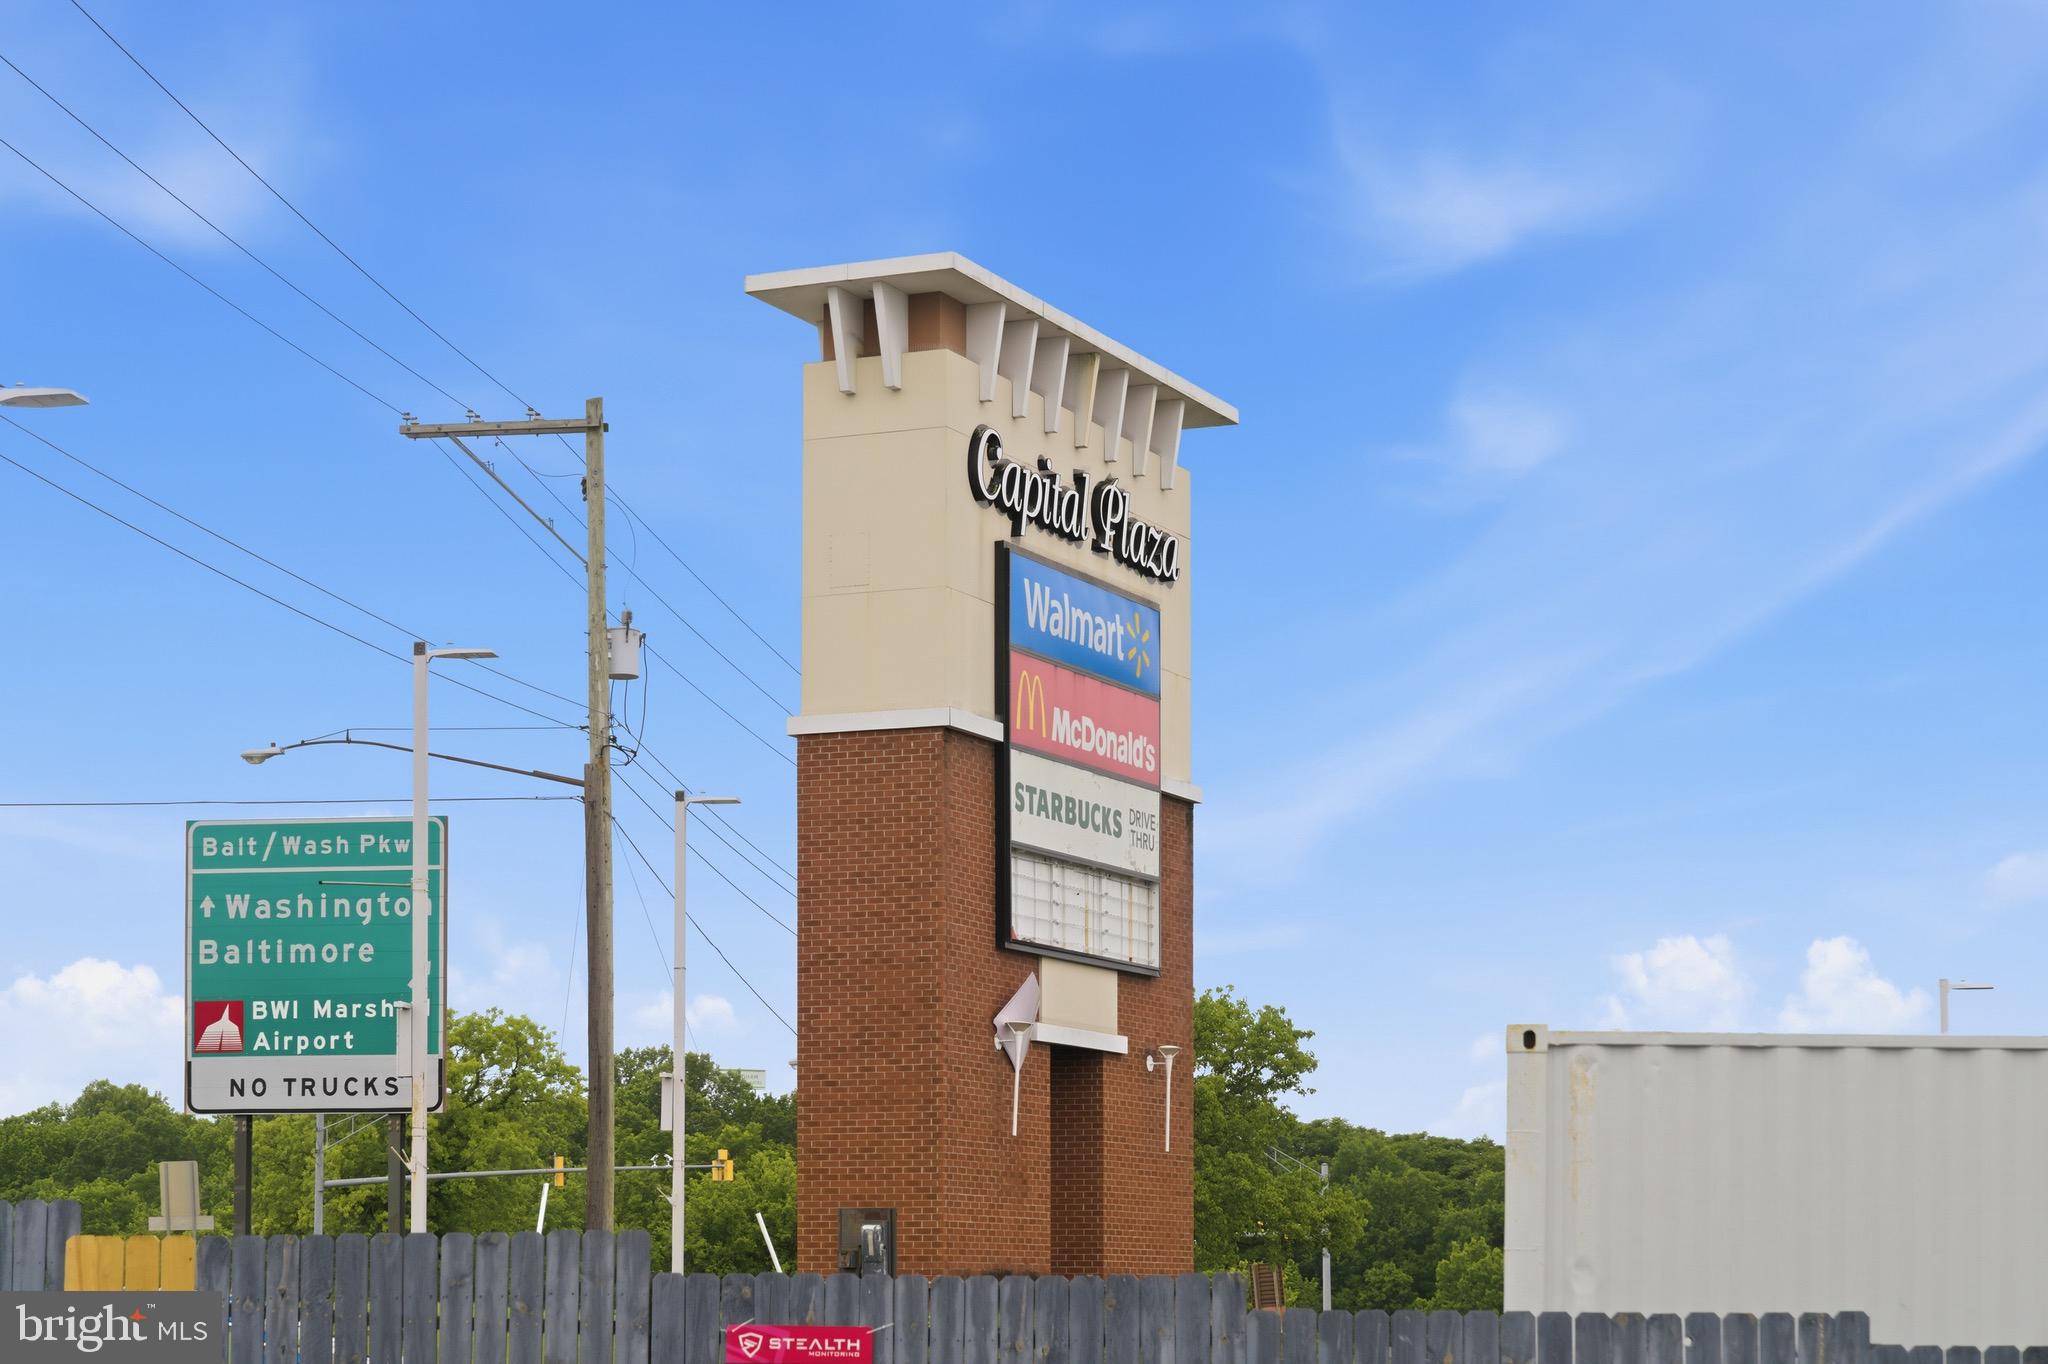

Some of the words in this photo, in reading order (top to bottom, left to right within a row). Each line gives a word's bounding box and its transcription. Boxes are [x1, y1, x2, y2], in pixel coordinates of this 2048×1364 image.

[969, 425, 1089, 538] Capital
[1093, 477, 1181, 580] Plaza
[1024, 578, 1124, 661] Walmart
[1051, 707, 1156, 772] McDonald's
[1014, 782, 1123, 839] STARBUCKS
[1129, 808, 1156, 831] DRIVE
[202, 832, 349, 862] Balt/Wash
[360, 834, 411, 853] Pkw
[1130, 829, 1155, 851] THRU
[225, 892, 432, 925] Washingto
[199, 939, 375, 965] Baltimore
[252, 1000, 298, 1020] BWI
[314, 999, 430, 1018] Marsh
[253, 1031, 354, 1055] Airport
[229, 1078, 267, 1097] NO
[284, 1076, 400, 1097] TRUCKS
[768, 1337, 860, 1351] STEALTH
